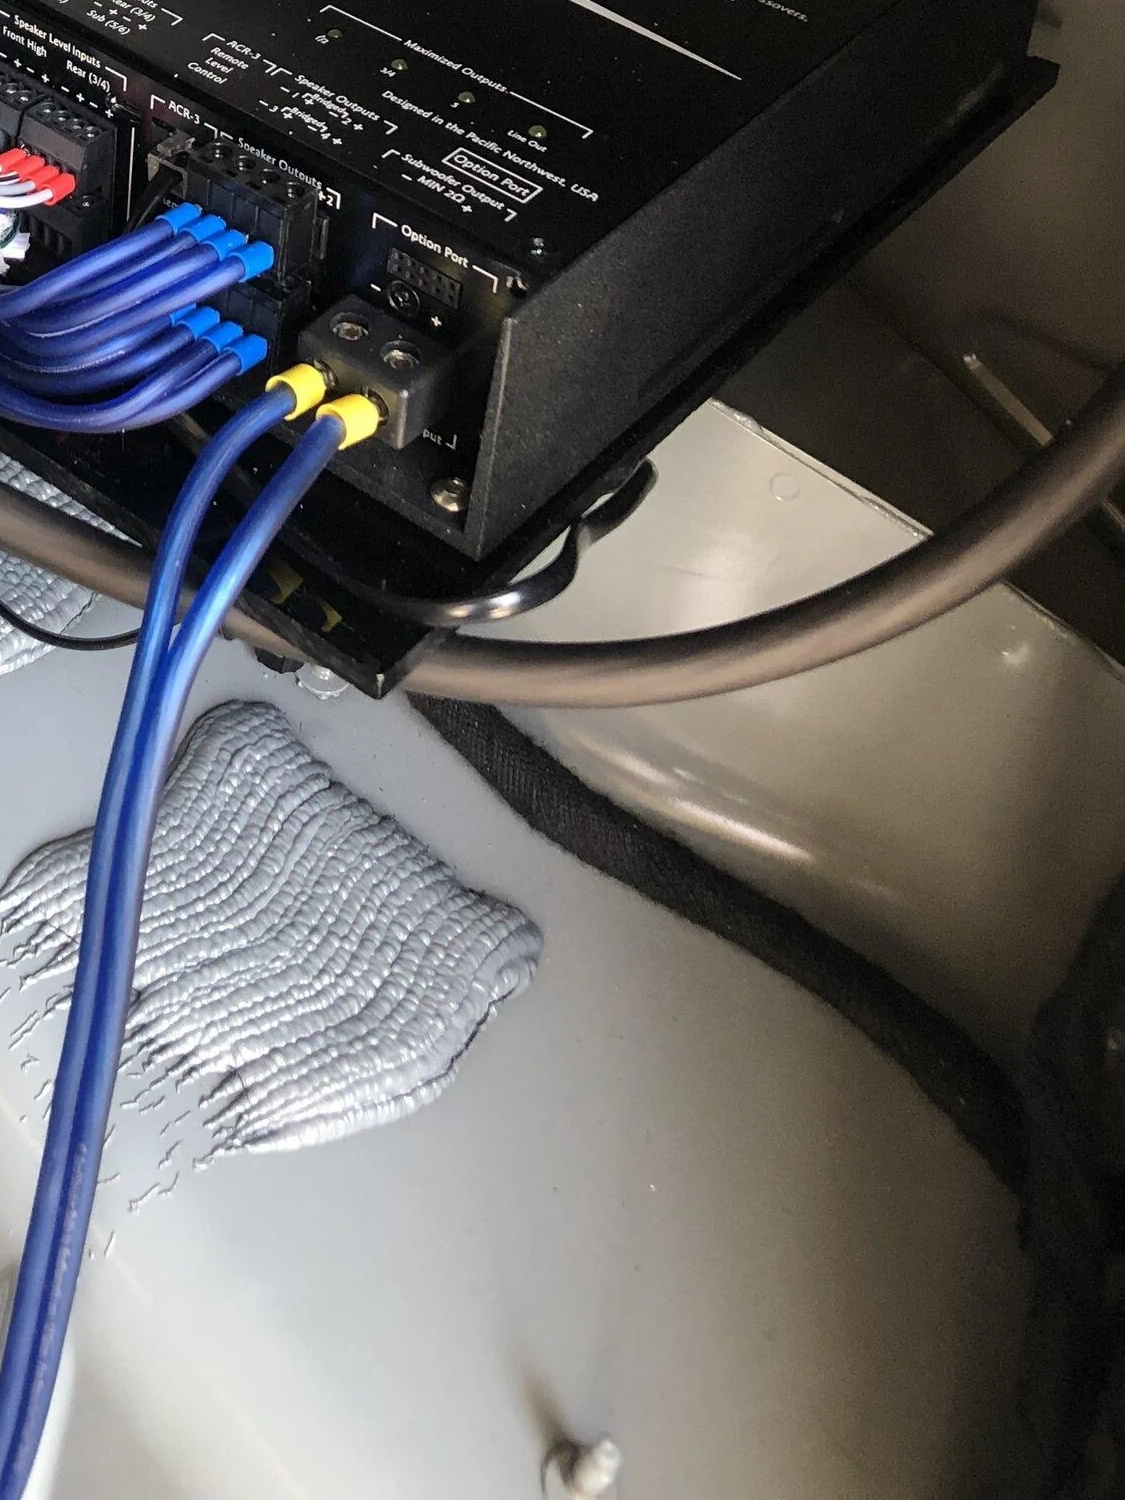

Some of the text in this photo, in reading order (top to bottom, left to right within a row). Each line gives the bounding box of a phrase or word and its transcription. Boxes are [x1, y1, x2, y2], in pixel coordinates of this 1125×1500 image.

[86, 9, 131, 36] Sub (5/6)
[130, 5, 156, 23] (3/4)
[2, 25, 48, 59] Front High
[14, 14, 102, 70] Speaker Level Inputs
[226, 40, 261, 61] ACR-3
[205, 56, 234, 74] Level
[210, 47, 250, 70] Remote
[403, 39, 508, 94] Maximized Outputs
[66, 59, 111, 94] Rear (3/4)
[187, 62, 228, 85] Control
[295, 75, 380, 121] Speaker Outputs
[310, 93, 347, 114] Bridged
[168, 100, 201, 125] ACR-3
[290, 107, 326, 128] Bridged
[381, 90, 433, 119] Designed
[431, 114, 443, 124] in
[445, 121, 464, 136] the
[465, 131, 502, 155] Pacific
[571, 183, 599, 202] USA
[507, 129, 548, 153] Line Out
[238, 138, 323, 190] Speaker Outputs
[453, 154, 531, 197] Option Port
[401, 153, 505, 210] Subwoofer Output
[417, 176, 445, 194] MIN
[400, 224, 469, 268] Option Port
